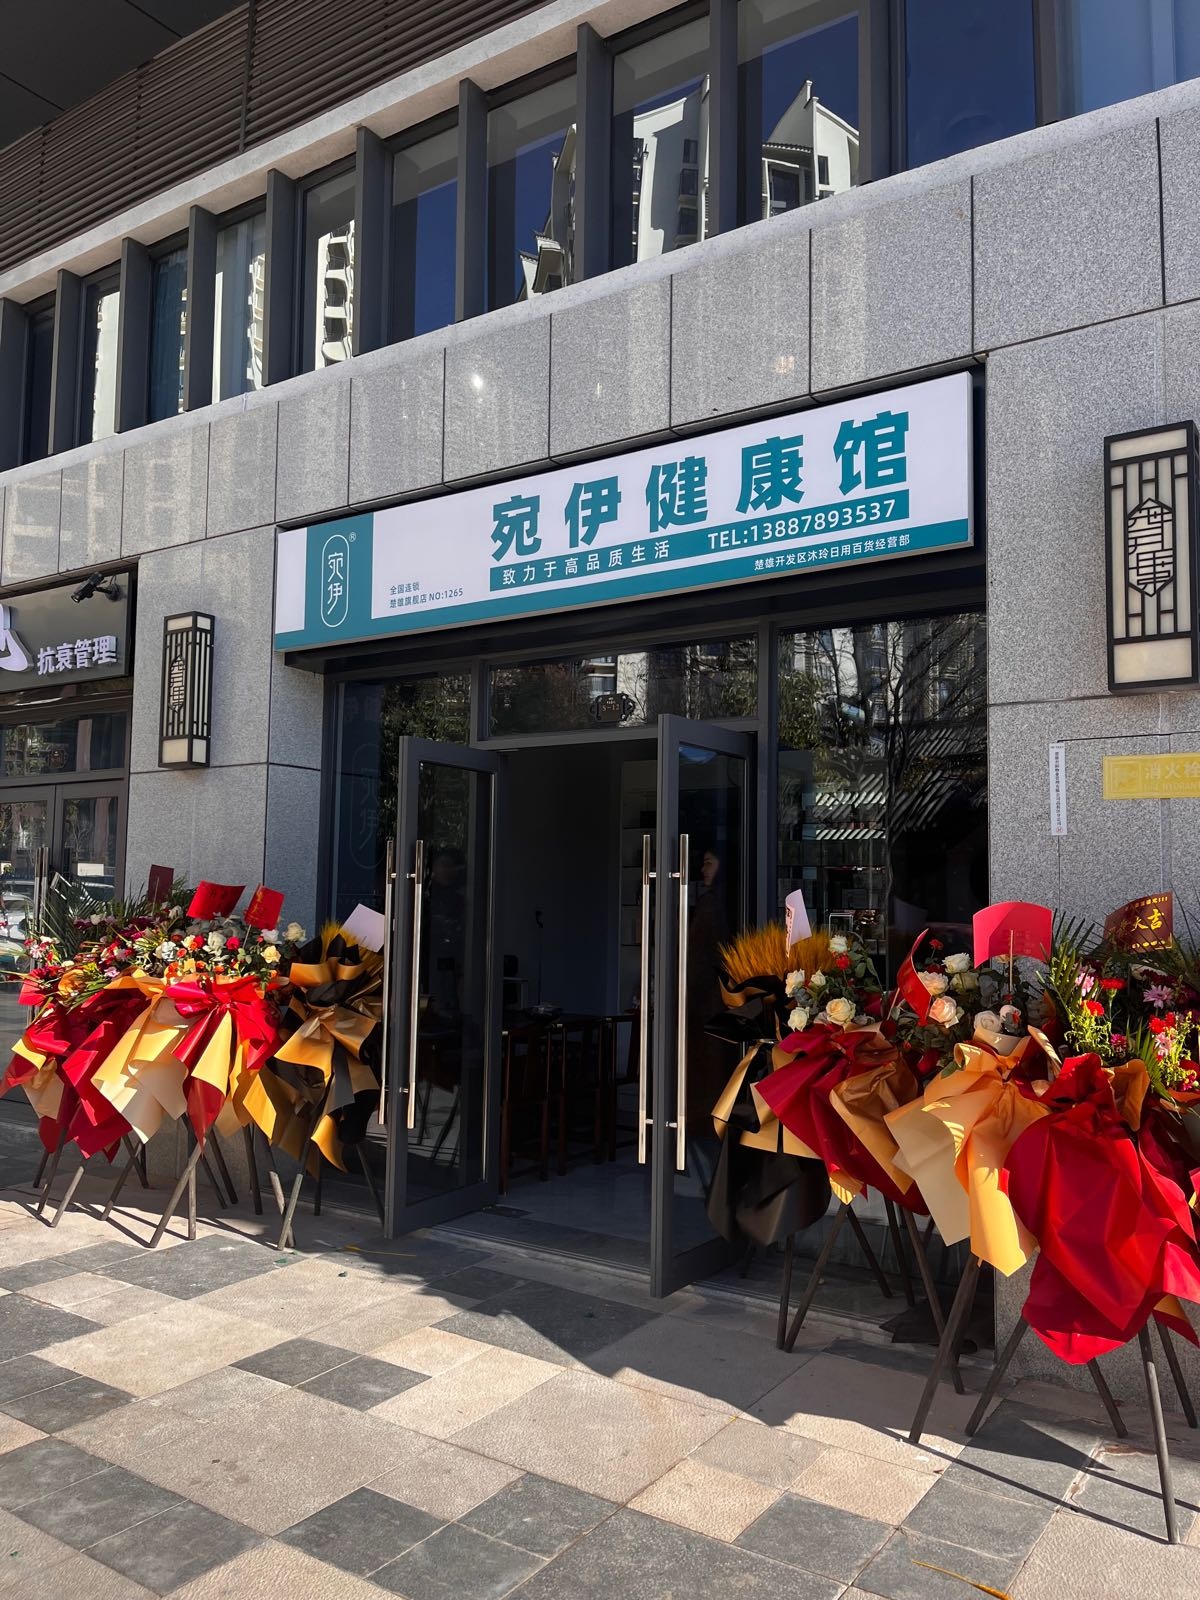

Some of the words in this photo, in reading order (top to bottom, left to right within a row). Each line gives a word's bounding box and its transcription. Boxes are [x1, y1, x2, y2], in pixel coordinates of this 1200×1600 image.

[490, 410, 910, 562] 宛伊健康馆
[707, 499, 896, 550] TEL:13887893537
[502, 540, 670, 586] 致力于高品质生活
[754, 534, 911, 571] 楚雄开发区沐玲日用百货经营部
[389, 581, 420, 596] 全国连锁
[389, 594, 428, 609] 楚雄旗舰店
[428, 587, 464, 602] NO:1265
[37, 635, 117, 676] 抗衰管理
